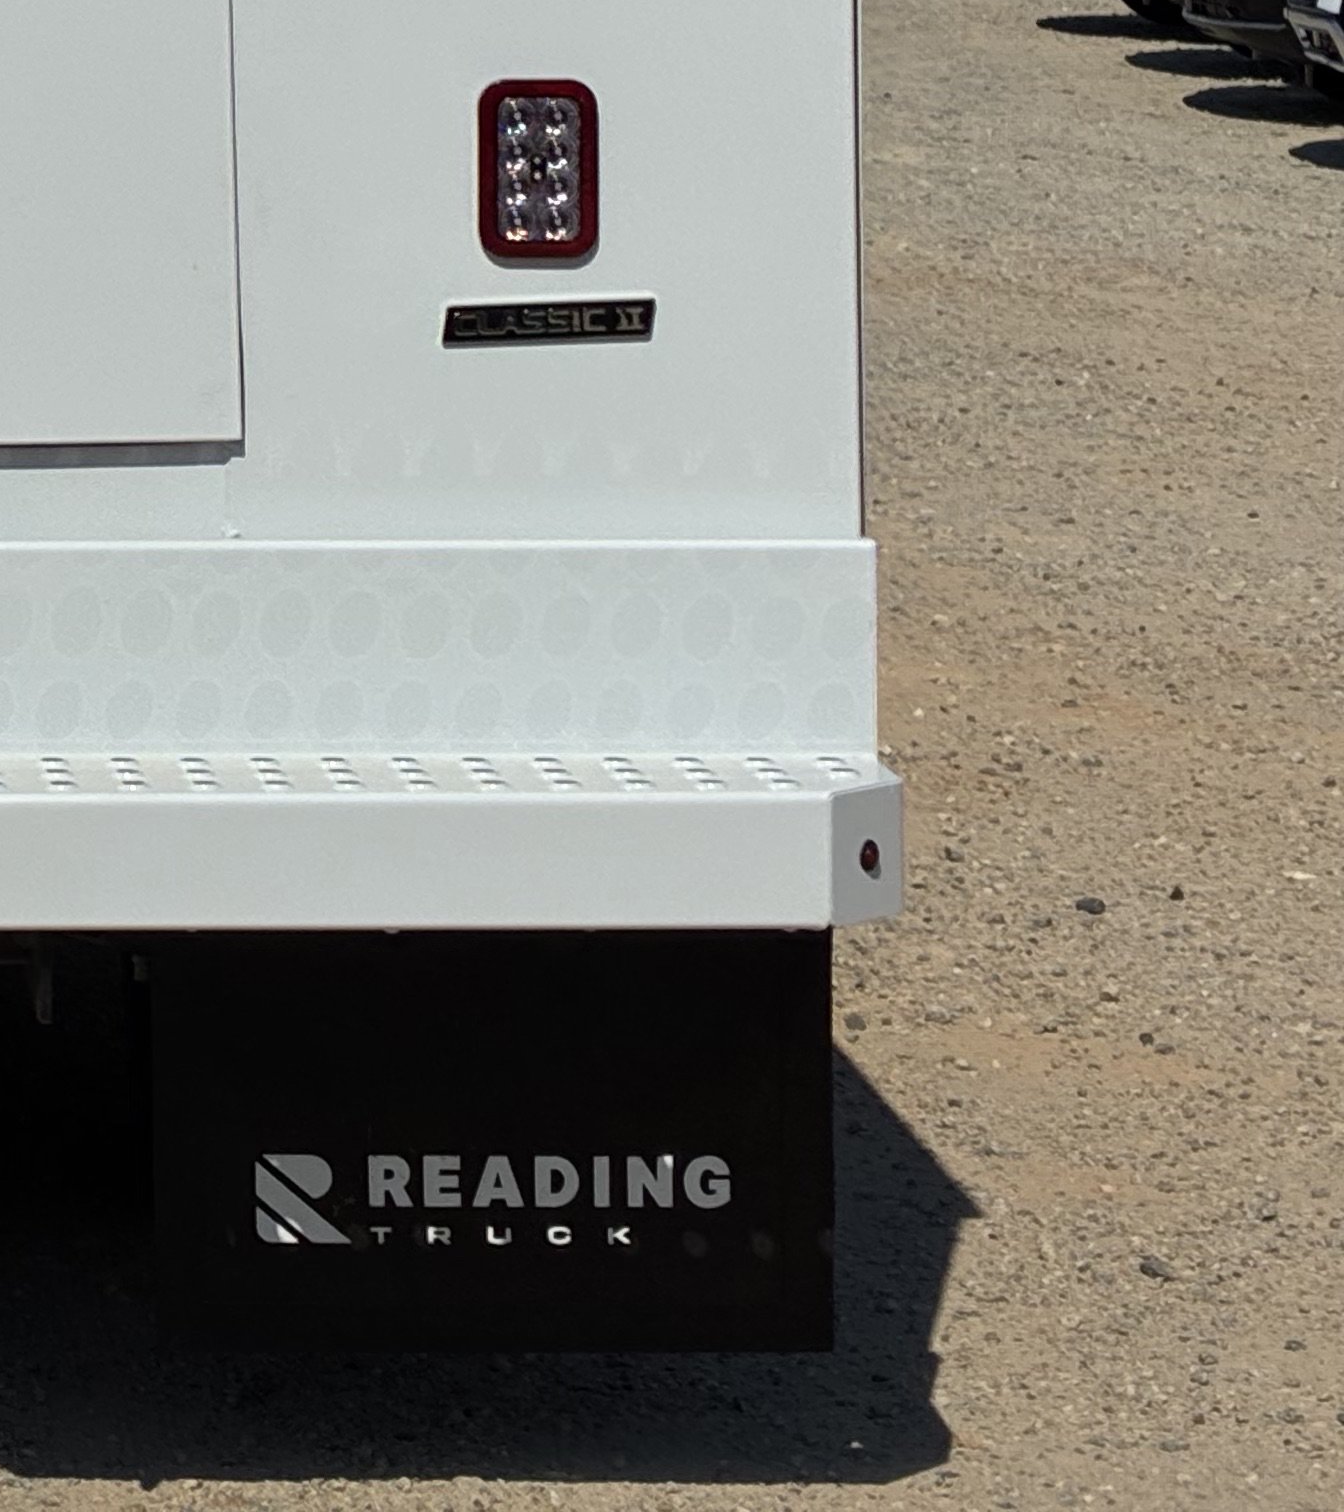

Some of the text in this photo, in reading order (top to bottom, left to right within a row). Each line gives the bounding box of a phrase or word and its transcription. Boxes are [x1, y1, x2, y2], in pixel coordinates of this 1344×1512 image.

[454, 307, 606, 337] CLASSIC
[368, 1152, 732, 1210] READING
[370, 1224, 632, 1246] TRUCK
